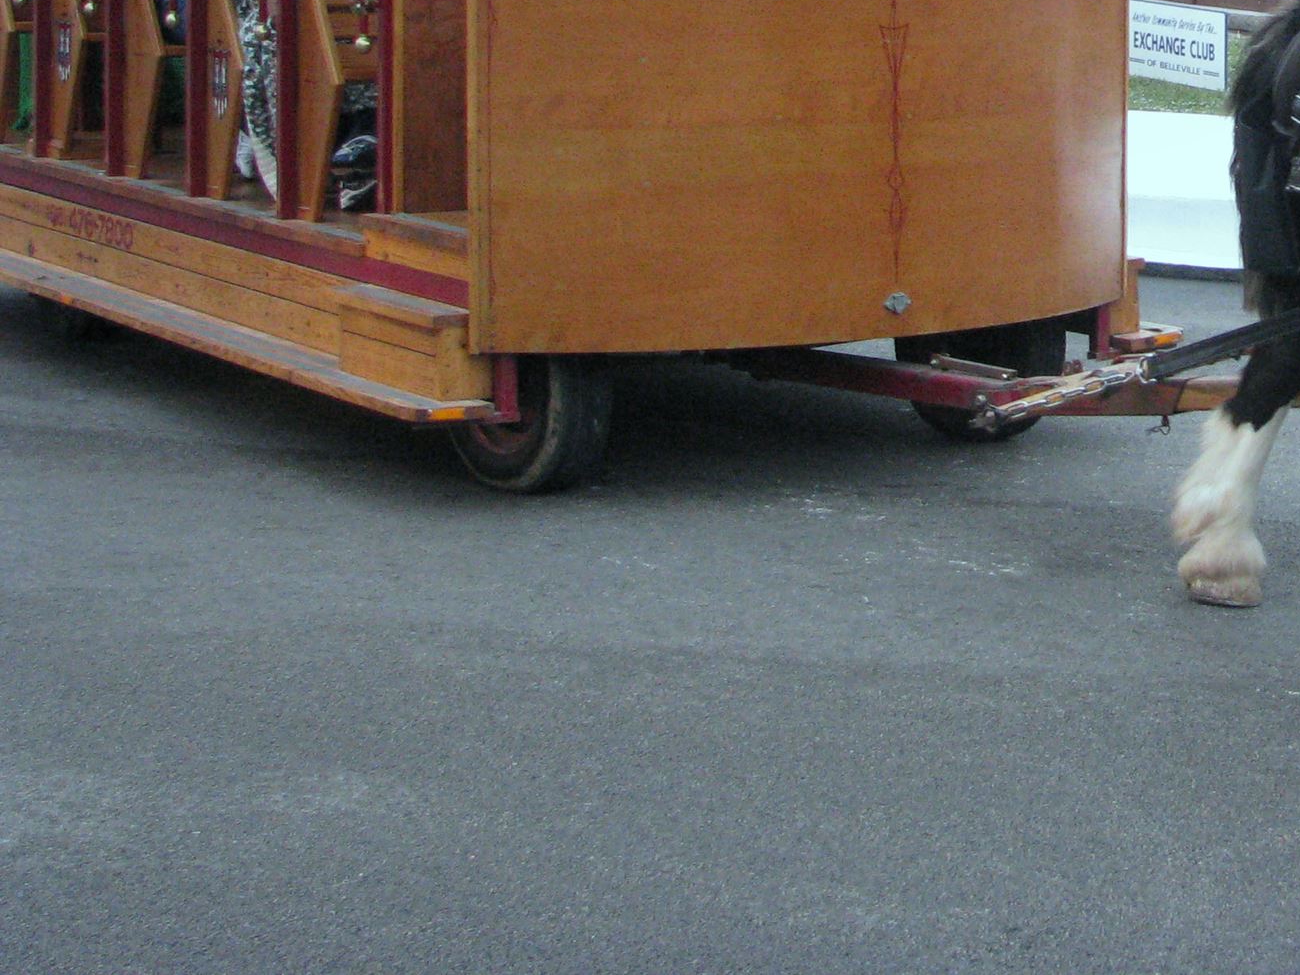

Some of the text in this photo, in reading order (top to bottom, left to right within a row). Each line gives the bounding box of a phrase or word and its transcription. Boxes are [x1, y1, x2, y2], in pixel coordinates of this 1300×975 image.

[1133, 31, 1215, 61] EXCHANGE CLUB
[1146, 59, 1200, 75] OF BELLEVILLE
